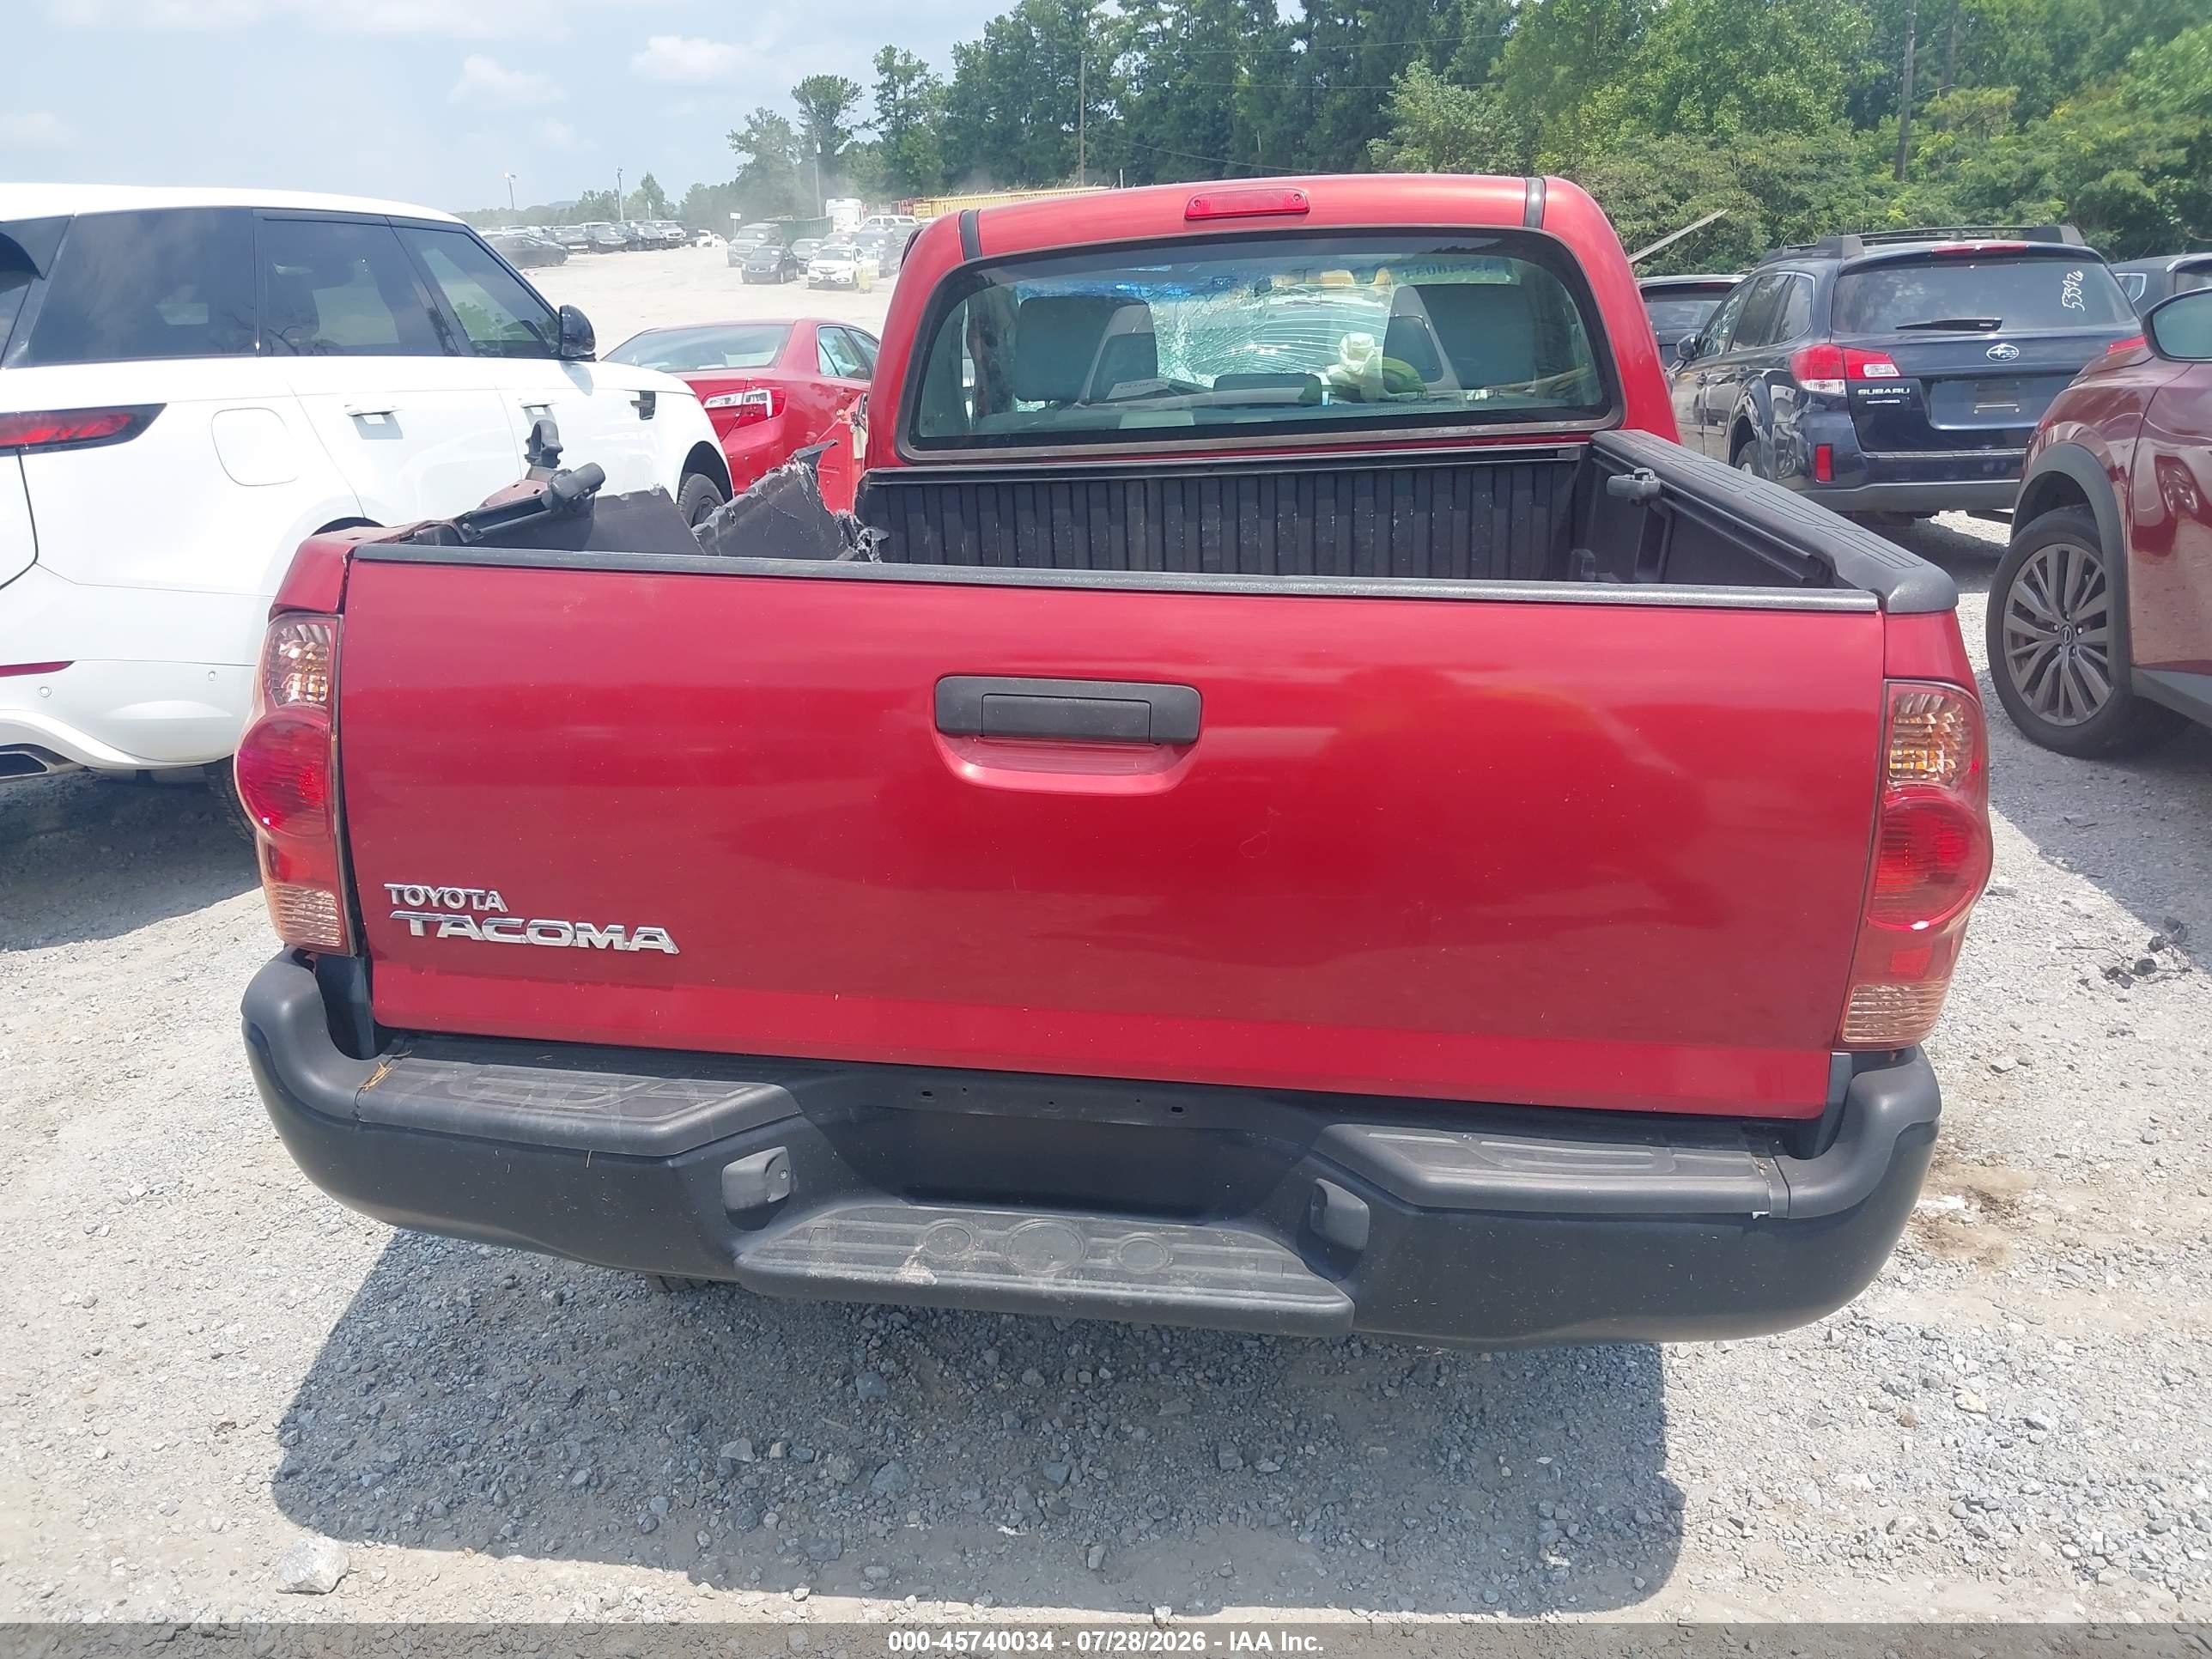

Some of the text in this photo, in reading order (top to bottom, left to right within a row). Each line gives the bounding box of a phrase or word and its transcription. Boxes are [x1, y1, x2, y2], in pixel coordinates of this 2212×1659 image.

[1857, 387, 1911, 396] SUBARU
[383, 882, 508, 913] TOYOTA
[389, 909, 681, 955] TACOMA
